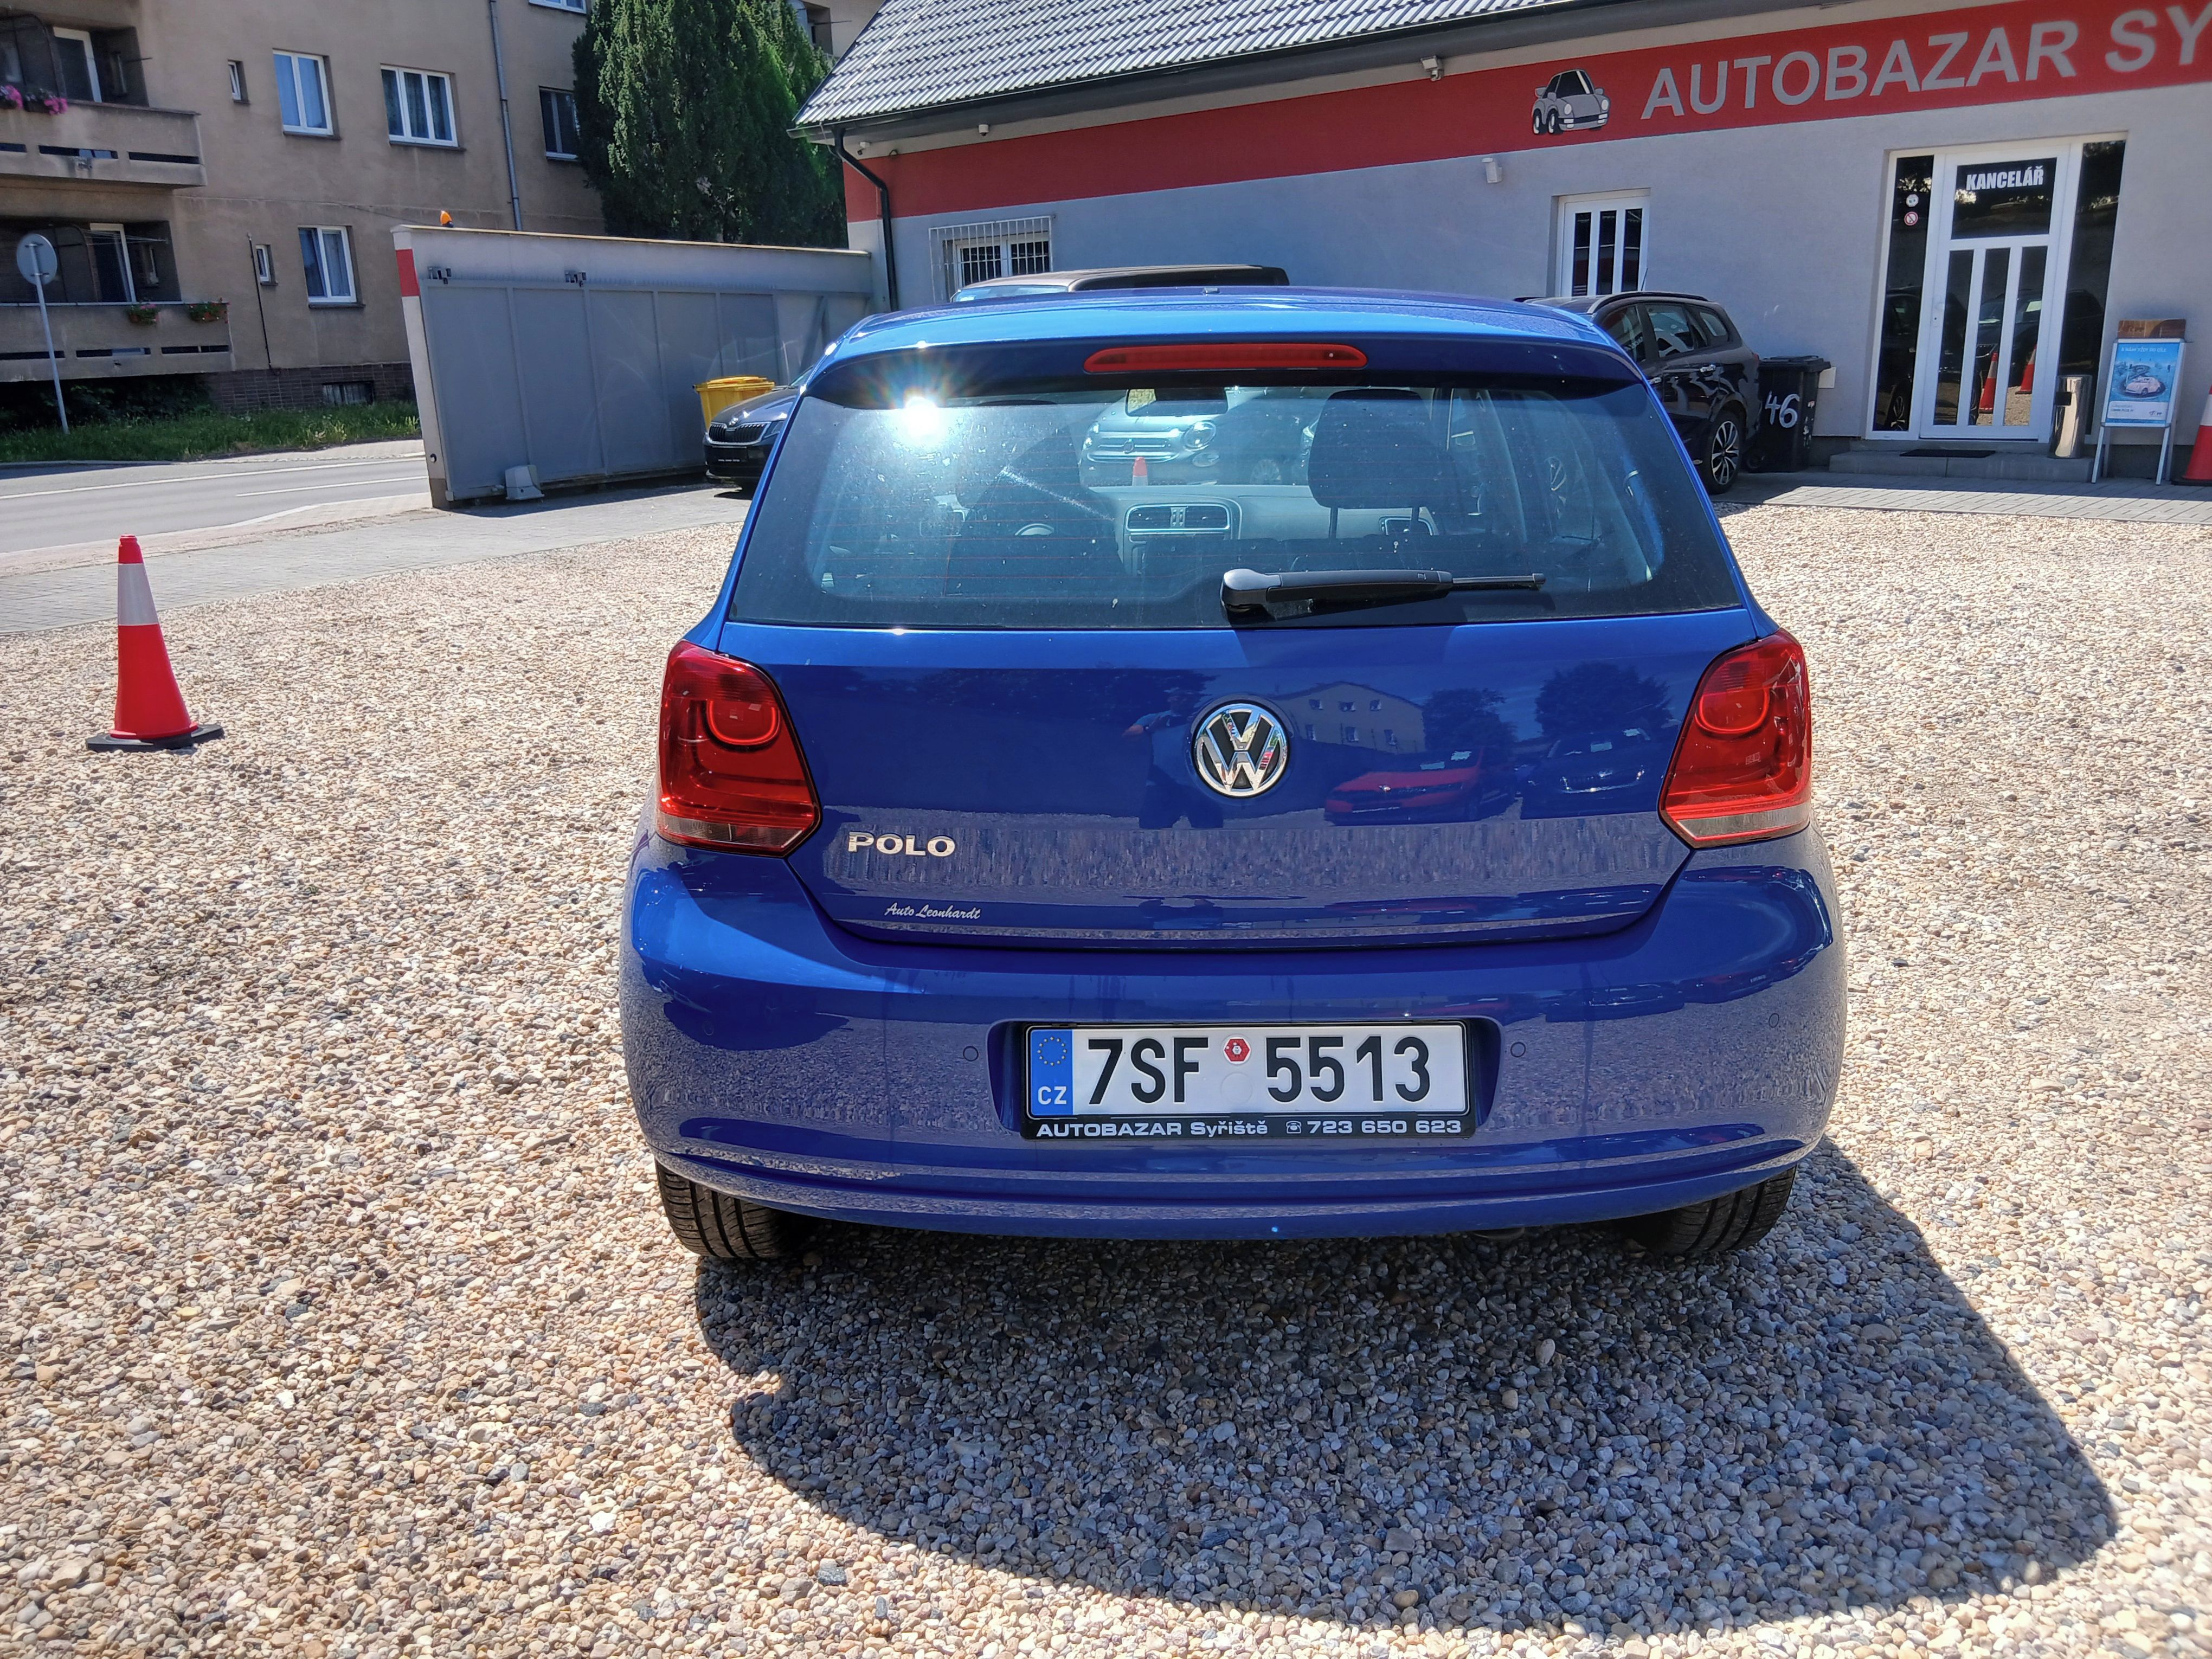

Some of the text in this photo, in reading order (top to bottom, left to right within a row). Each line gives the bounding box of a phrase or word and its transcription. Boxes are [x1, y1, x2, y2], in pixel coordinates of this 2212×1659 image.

[1641, 0, 2212, 120] AUTOBAZAR SY
[1966, 165, 2044, 191] KANCELÁŘ
[1765, 391, 1800, 428] 46
[1197, 703, 1287, 796] VW
[848, 832, 955, 857] POLO
[884, 902, 981, 919] Auto Leonhardt
[1088, 1036, 1430, 1105] 7SF 5513
[1038, 1086, 1067, 1105] CZ
[1036, 1120, 1461, 1137] AUTOBAZAR Syřiště 723 650 623
